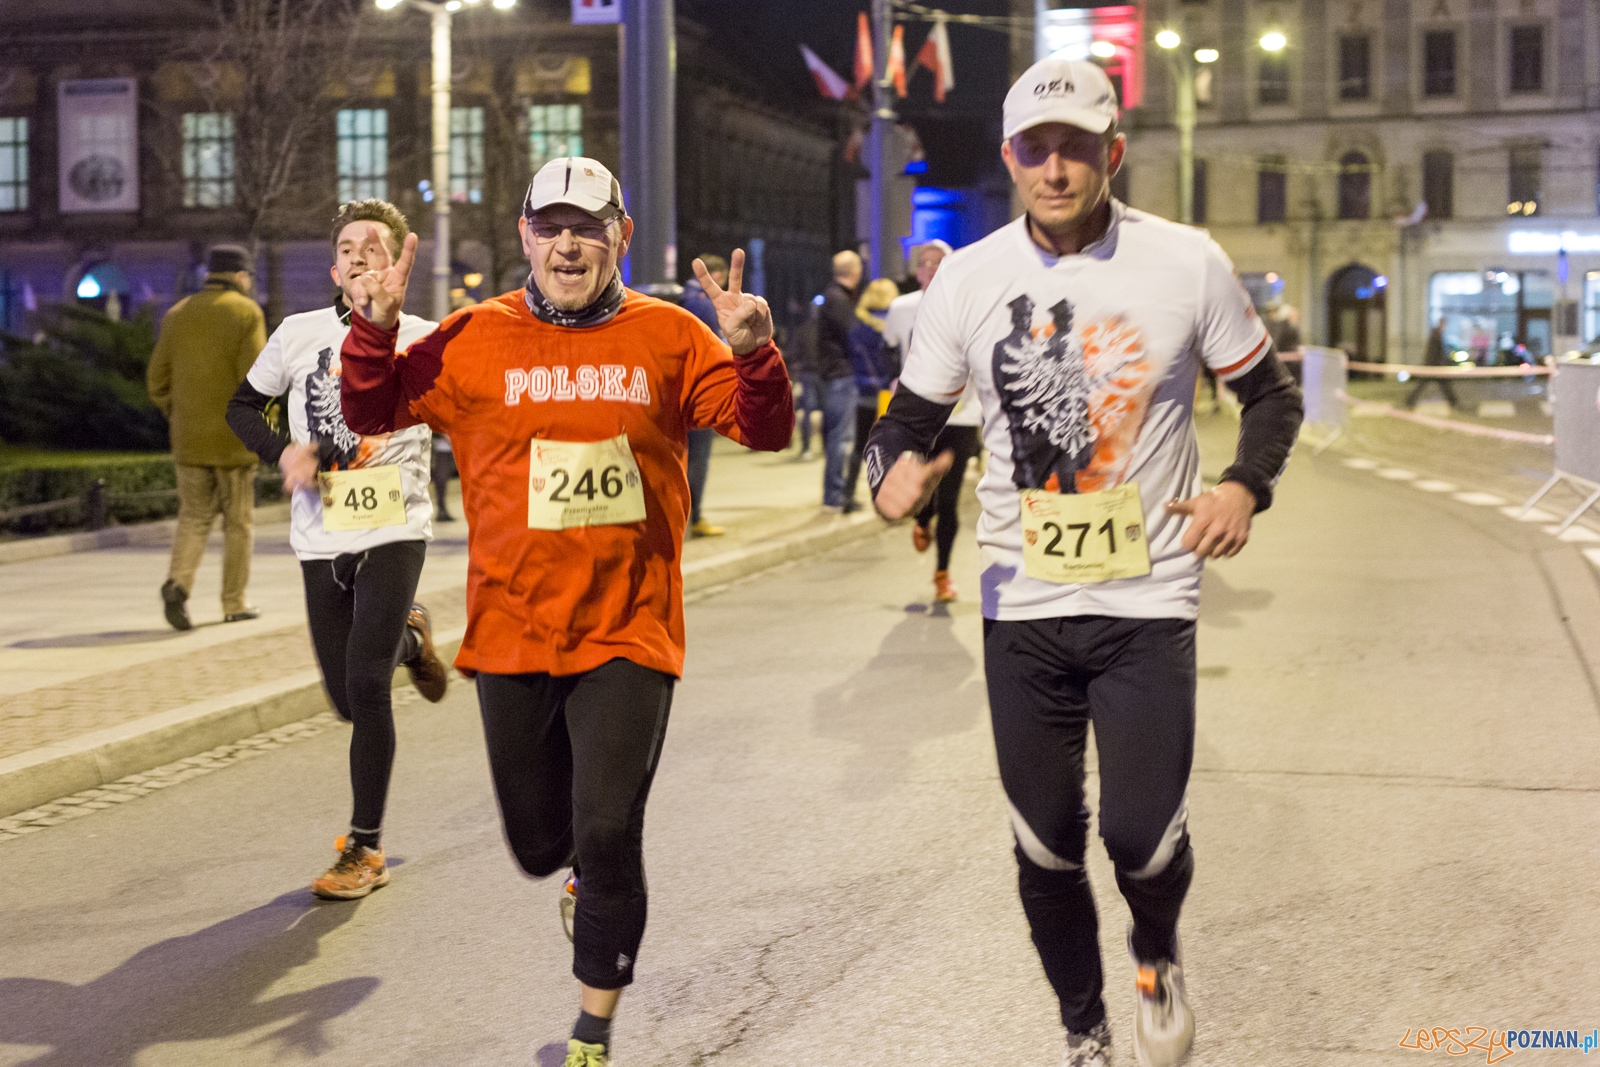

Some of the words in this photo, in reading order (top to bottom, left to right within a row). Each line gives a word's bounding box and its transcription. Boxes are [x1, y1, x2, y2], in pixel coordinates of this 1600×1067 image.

[504, 364, 651, 406] POLSKA
[344, 486, 378, 511] 48
[548, 465, 623, 503] 246
[1042, 516, 1117, 558] 271
